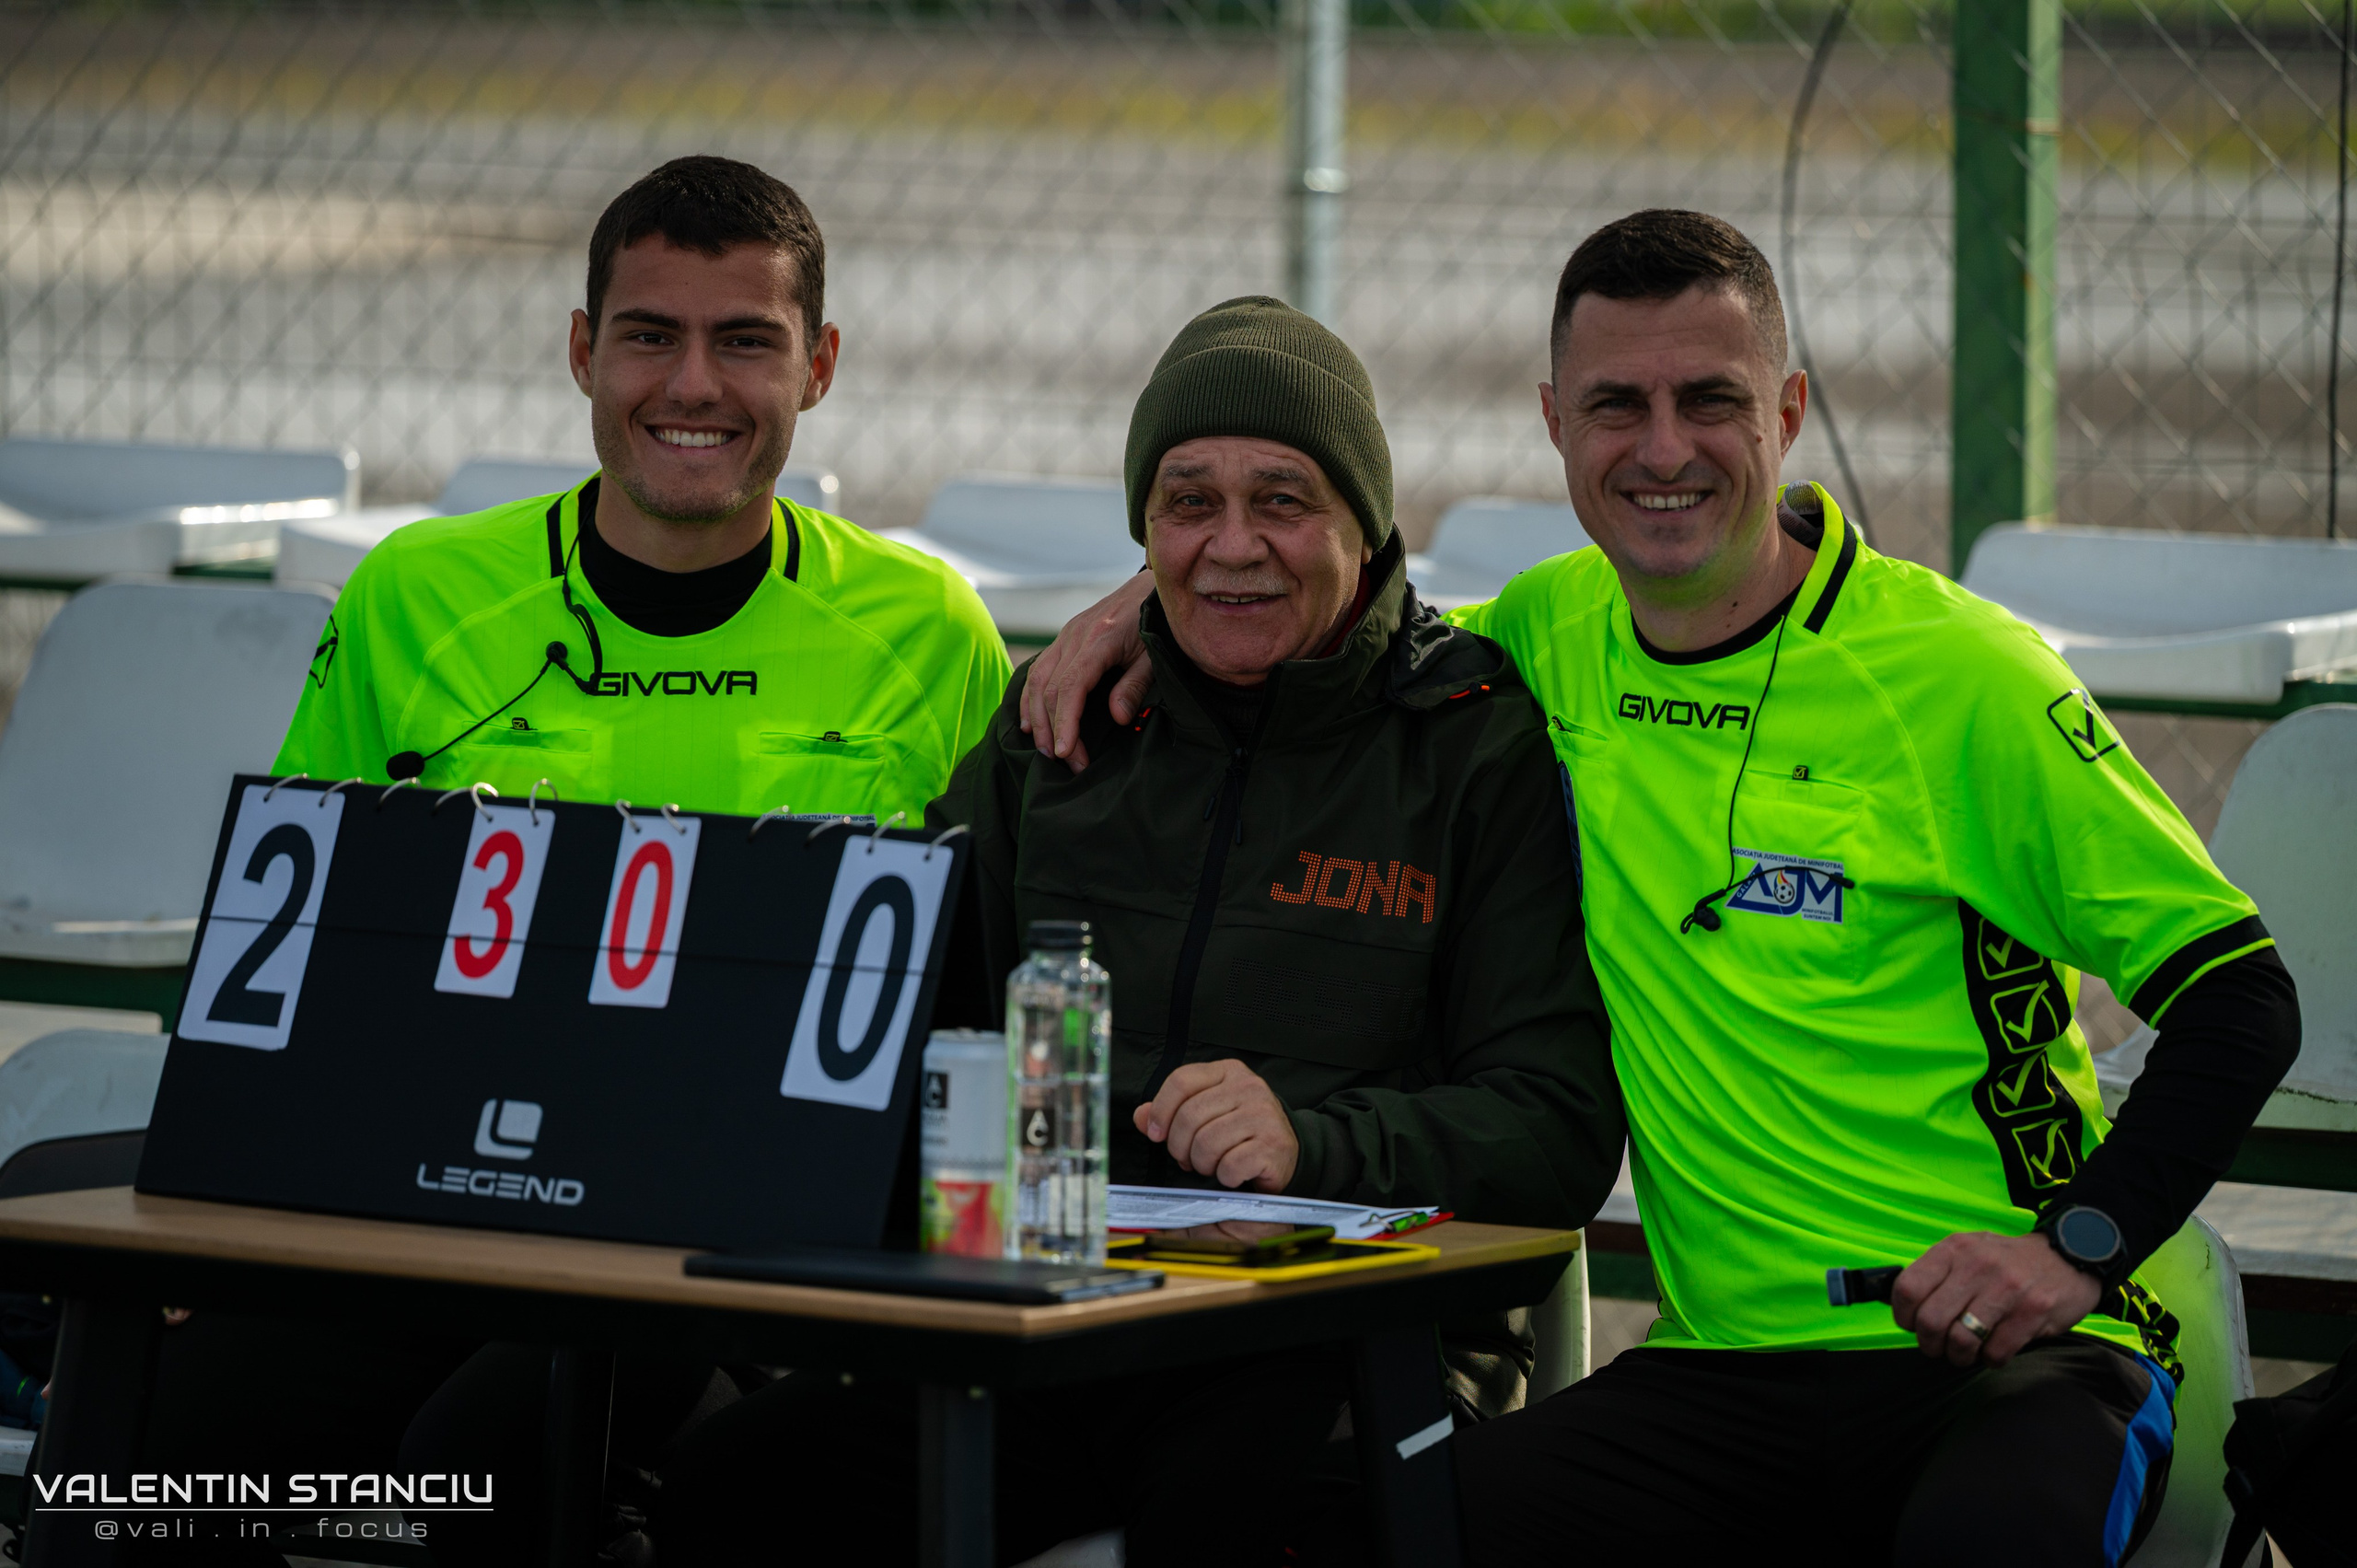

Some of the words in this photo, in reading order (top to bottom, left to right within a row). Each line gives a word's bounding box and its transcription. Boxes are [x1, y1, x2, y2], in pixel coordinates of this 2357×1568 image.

[589, 671, 757, 697] GIVOVA
[1619, 692, 1750, 730] GIVOVA
[1807, 860, 1843, 870] MINIFOTBAL
[1271, 850, 1436, 923] JONA
[205, 823, 316, 1028] 2
[453, 830, 524, 979] 3
[607, 840, 674, 991] 0
[818, 872, 914, 1085] 0
[416, 1163, 585, 1206] LEGEND
